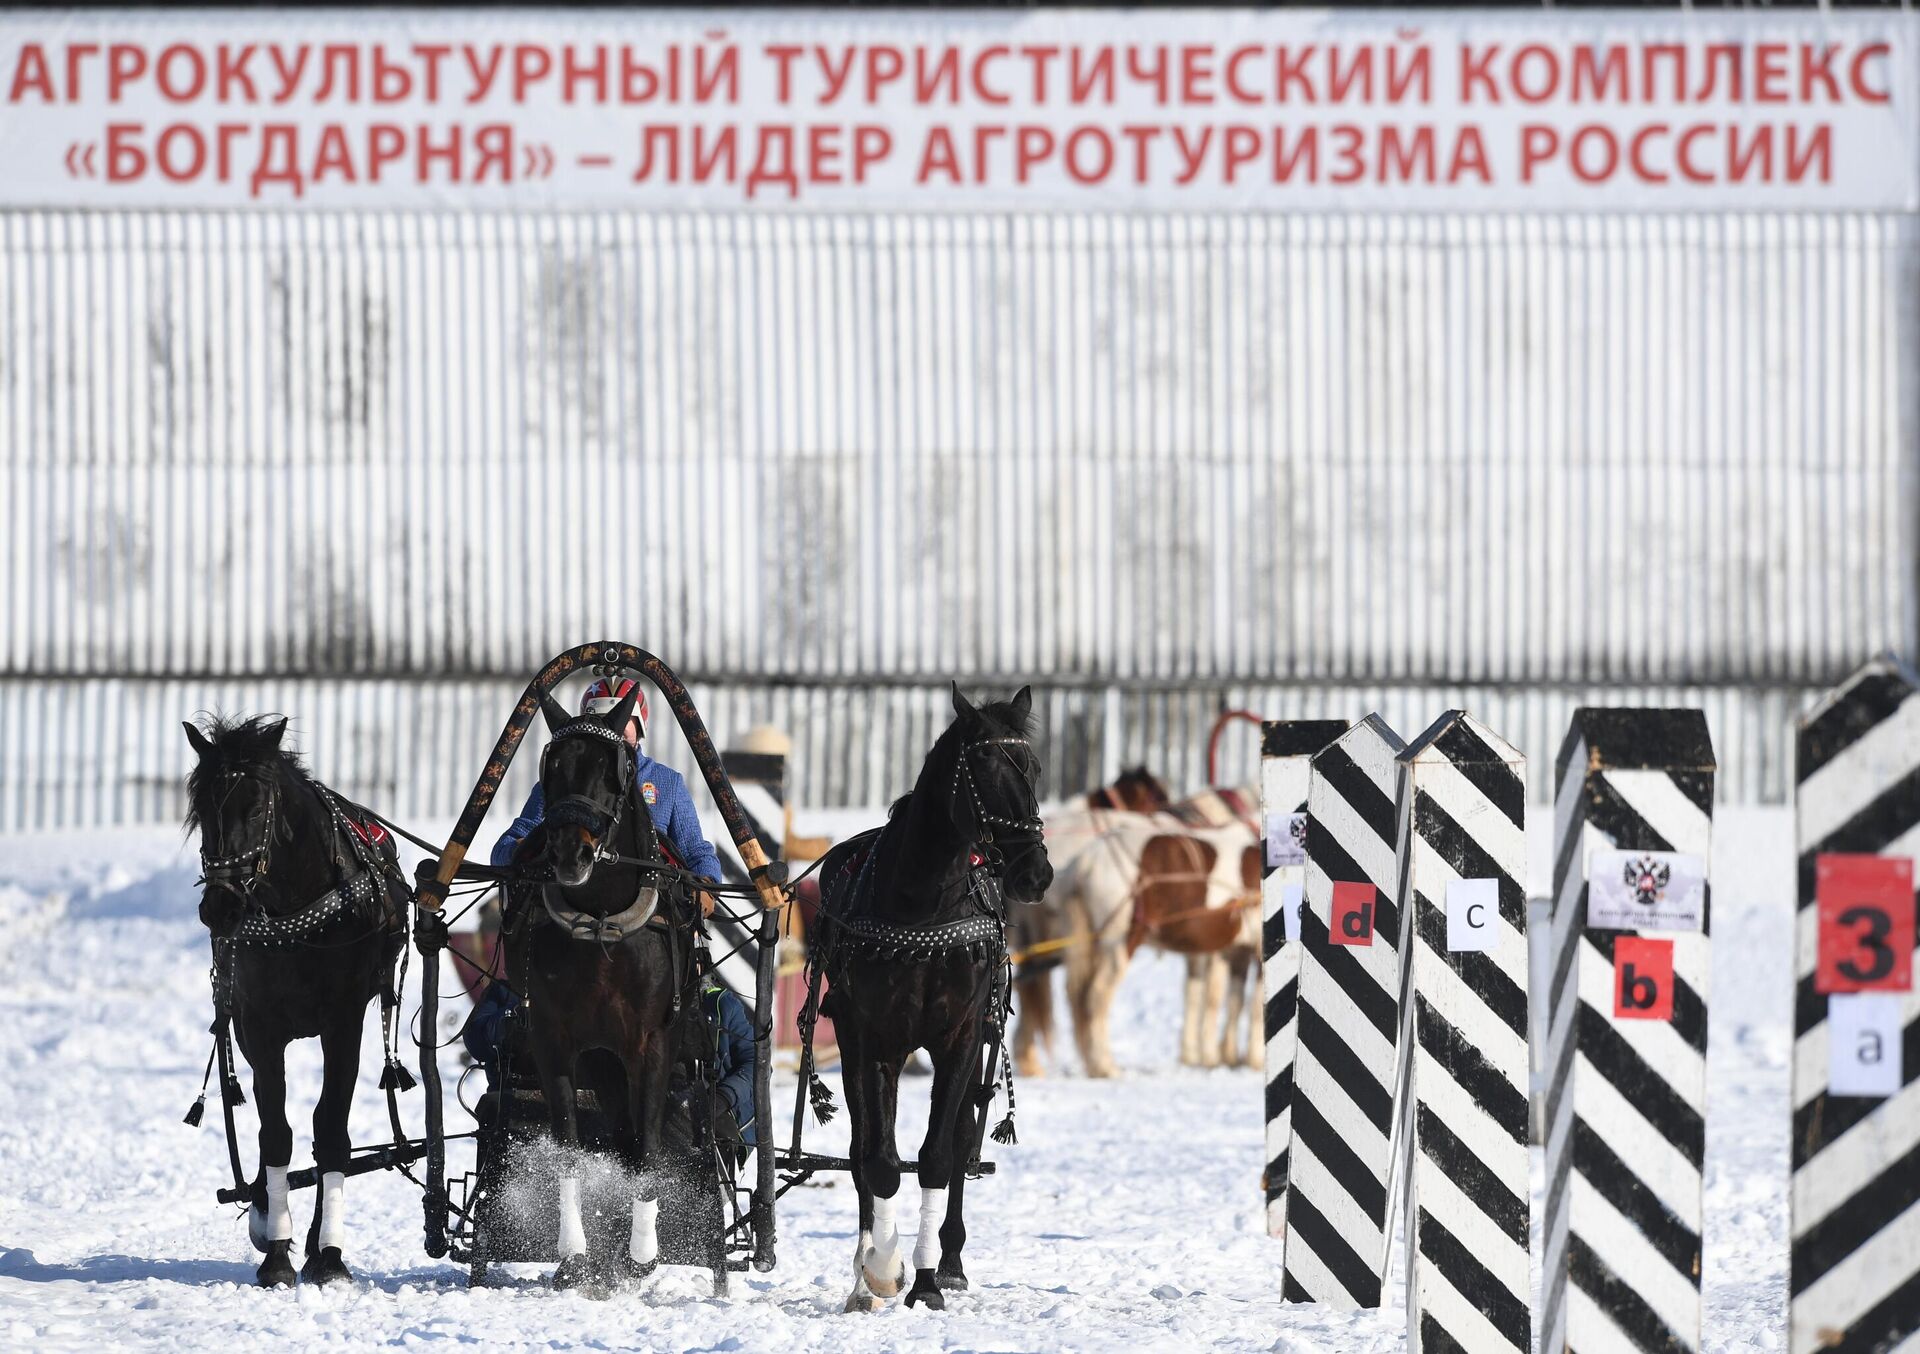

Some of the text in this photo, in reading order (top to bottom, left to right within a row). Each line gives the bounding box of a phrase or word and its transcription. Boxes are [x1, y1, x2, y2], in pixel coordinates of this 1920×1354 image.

[8, 30, 1891, 104] АГРОКУЛЬТУРНЫЙ ТУРИСТИЧЕСКИЙ КОМПЛЕКС
[64, 122, 556, 199] «БОГДАРНЯ»
[632, 123, 893, 199] ЛИДЕР
[915, 123, 1494, 185] АГРОТУРИЗМА
[1520, 123, 1834, 185] РОССИИ
[1342, 902, 1371, 938] d
[1835, 906, 1896, 983] 3
[1621, 963, 1657, 1010] b
[1858, 1031, 1882, 1065] a
